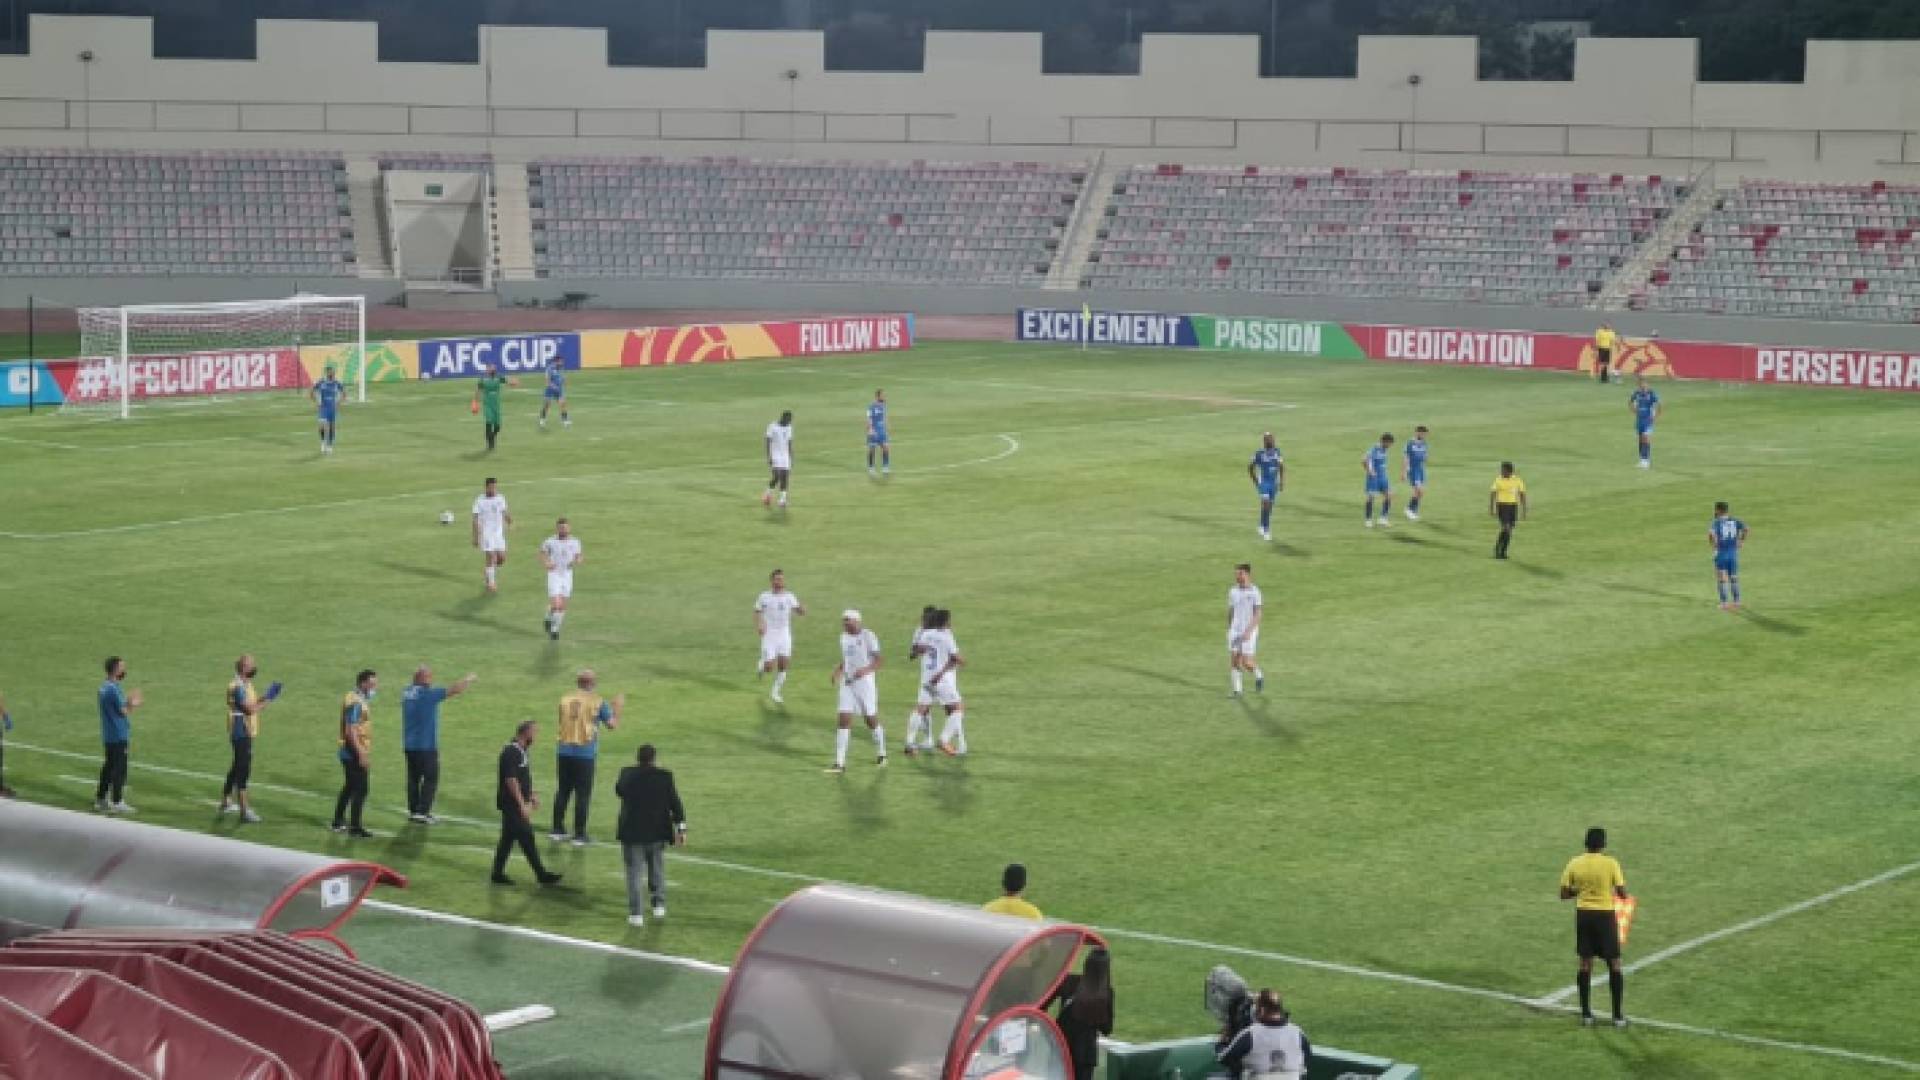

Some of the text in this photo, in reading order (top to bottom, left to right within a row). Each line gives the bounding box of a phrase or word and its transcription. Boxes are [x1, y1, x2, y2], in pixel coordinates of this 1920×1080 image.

[801, 318, 900, 354] FOLLOW US
[1022, 309, 1180, 344] EXCITEMENT
[1214, 318, 1322, 354] PASSION
[434, 339, 557, 376] AFC CUP
[1385, 328, 1535, 365] DEDICATION
[1757, 349, 1920, 388] PERSEVERA
